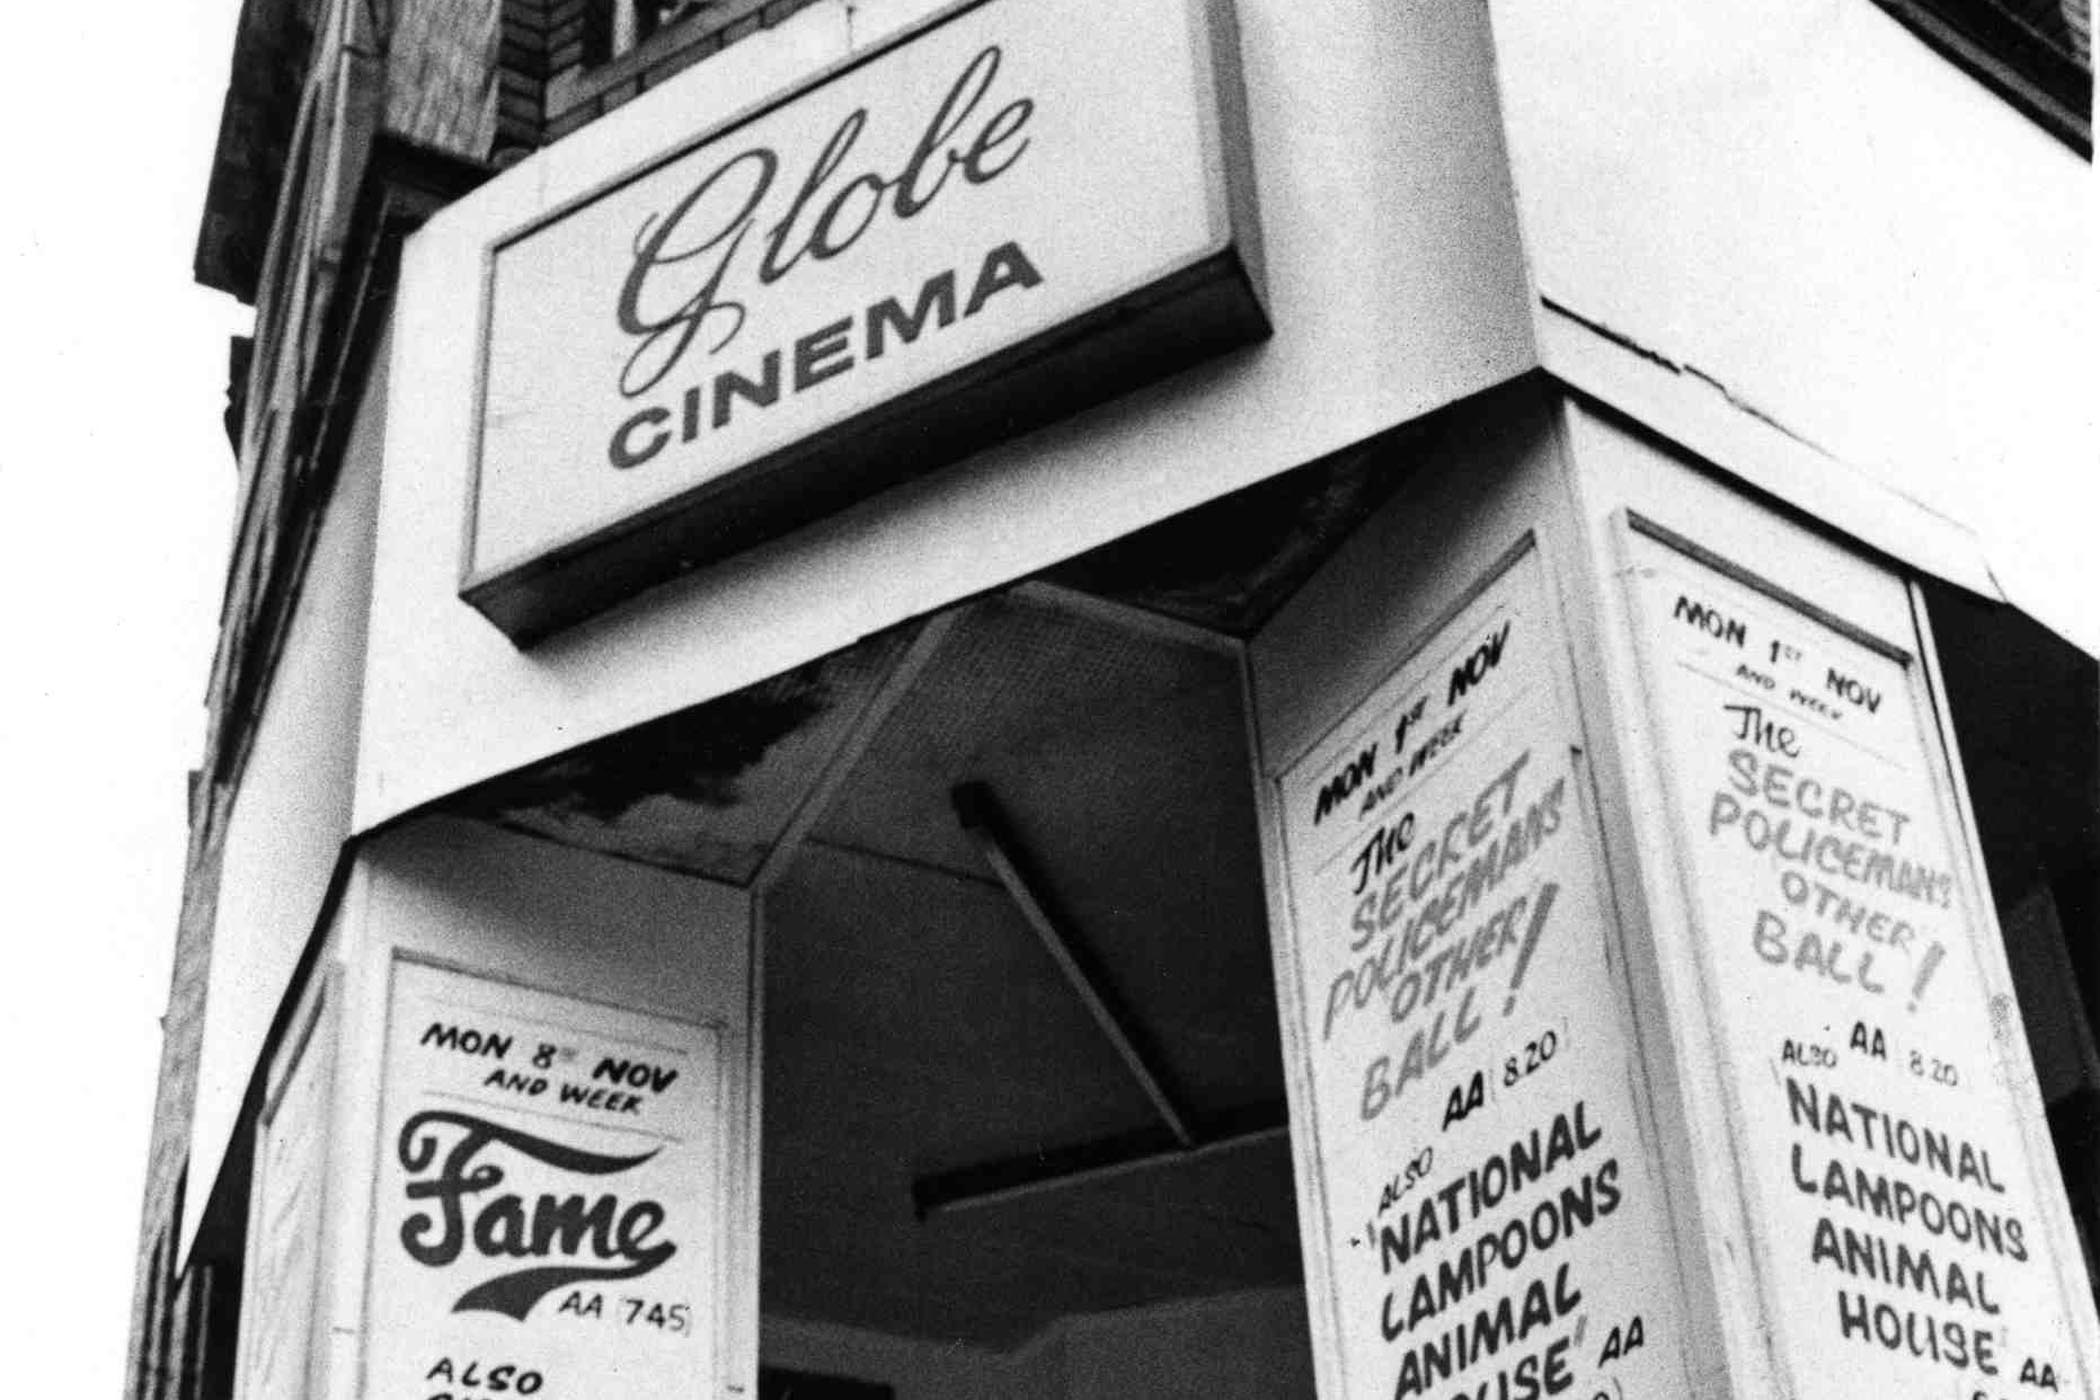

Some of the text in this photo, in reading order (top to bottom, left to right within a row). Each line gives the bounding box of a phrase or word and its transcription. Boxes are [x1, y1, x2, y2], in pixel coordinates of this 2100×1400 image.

[617, 45, 1035, 399] Globe
[608, 240, 1043, 470] CINEMA
[1673, 595, 1747, 649] MON
[1825, 666, 1881, 714] NOV
[1313, 742, 1379, 827] MON
[1447, 617, 1511, 707] NOV
[1728, 749, 1911, 844] SECRET
[1350, 750, 1530, 951] SECRET
[1391, 895, 1528, 1024] OTHER
[1781, 870, 1916, 953] OTHER
[420, 1022, 513, 1059] MON
[592, 1056, 681, 1095] NOV
[1781, 1038, 1838, 1070] ALSO
[1850, 1020, 1887, 1062] AA
[484, 1068, 644, 1116] AND WEEK
[1442, 1069, 1485, 1133] AA
[1786, 1075, 2006, 1195] NATIONAL
[398, 1109, 678, 1322] Fame
[1377, 1144, 1434, 1220] ALSO
[1791, 1143, 2030, 1264] LAMPOONS
[1381, 1157, 1622, 1343] LAMPOONS
[1811, 1217, 2001, 1316] ANIMAL
[559, 1289, 603, 1319] AA
[1394, 1261, 1583, 1400] ANIMAL
[1597, 1315, 1645, 1371] AA
[1838, 1289, 2059, 1393] HOUSE AA
[426, 1355, 545, 1396] ALSO
